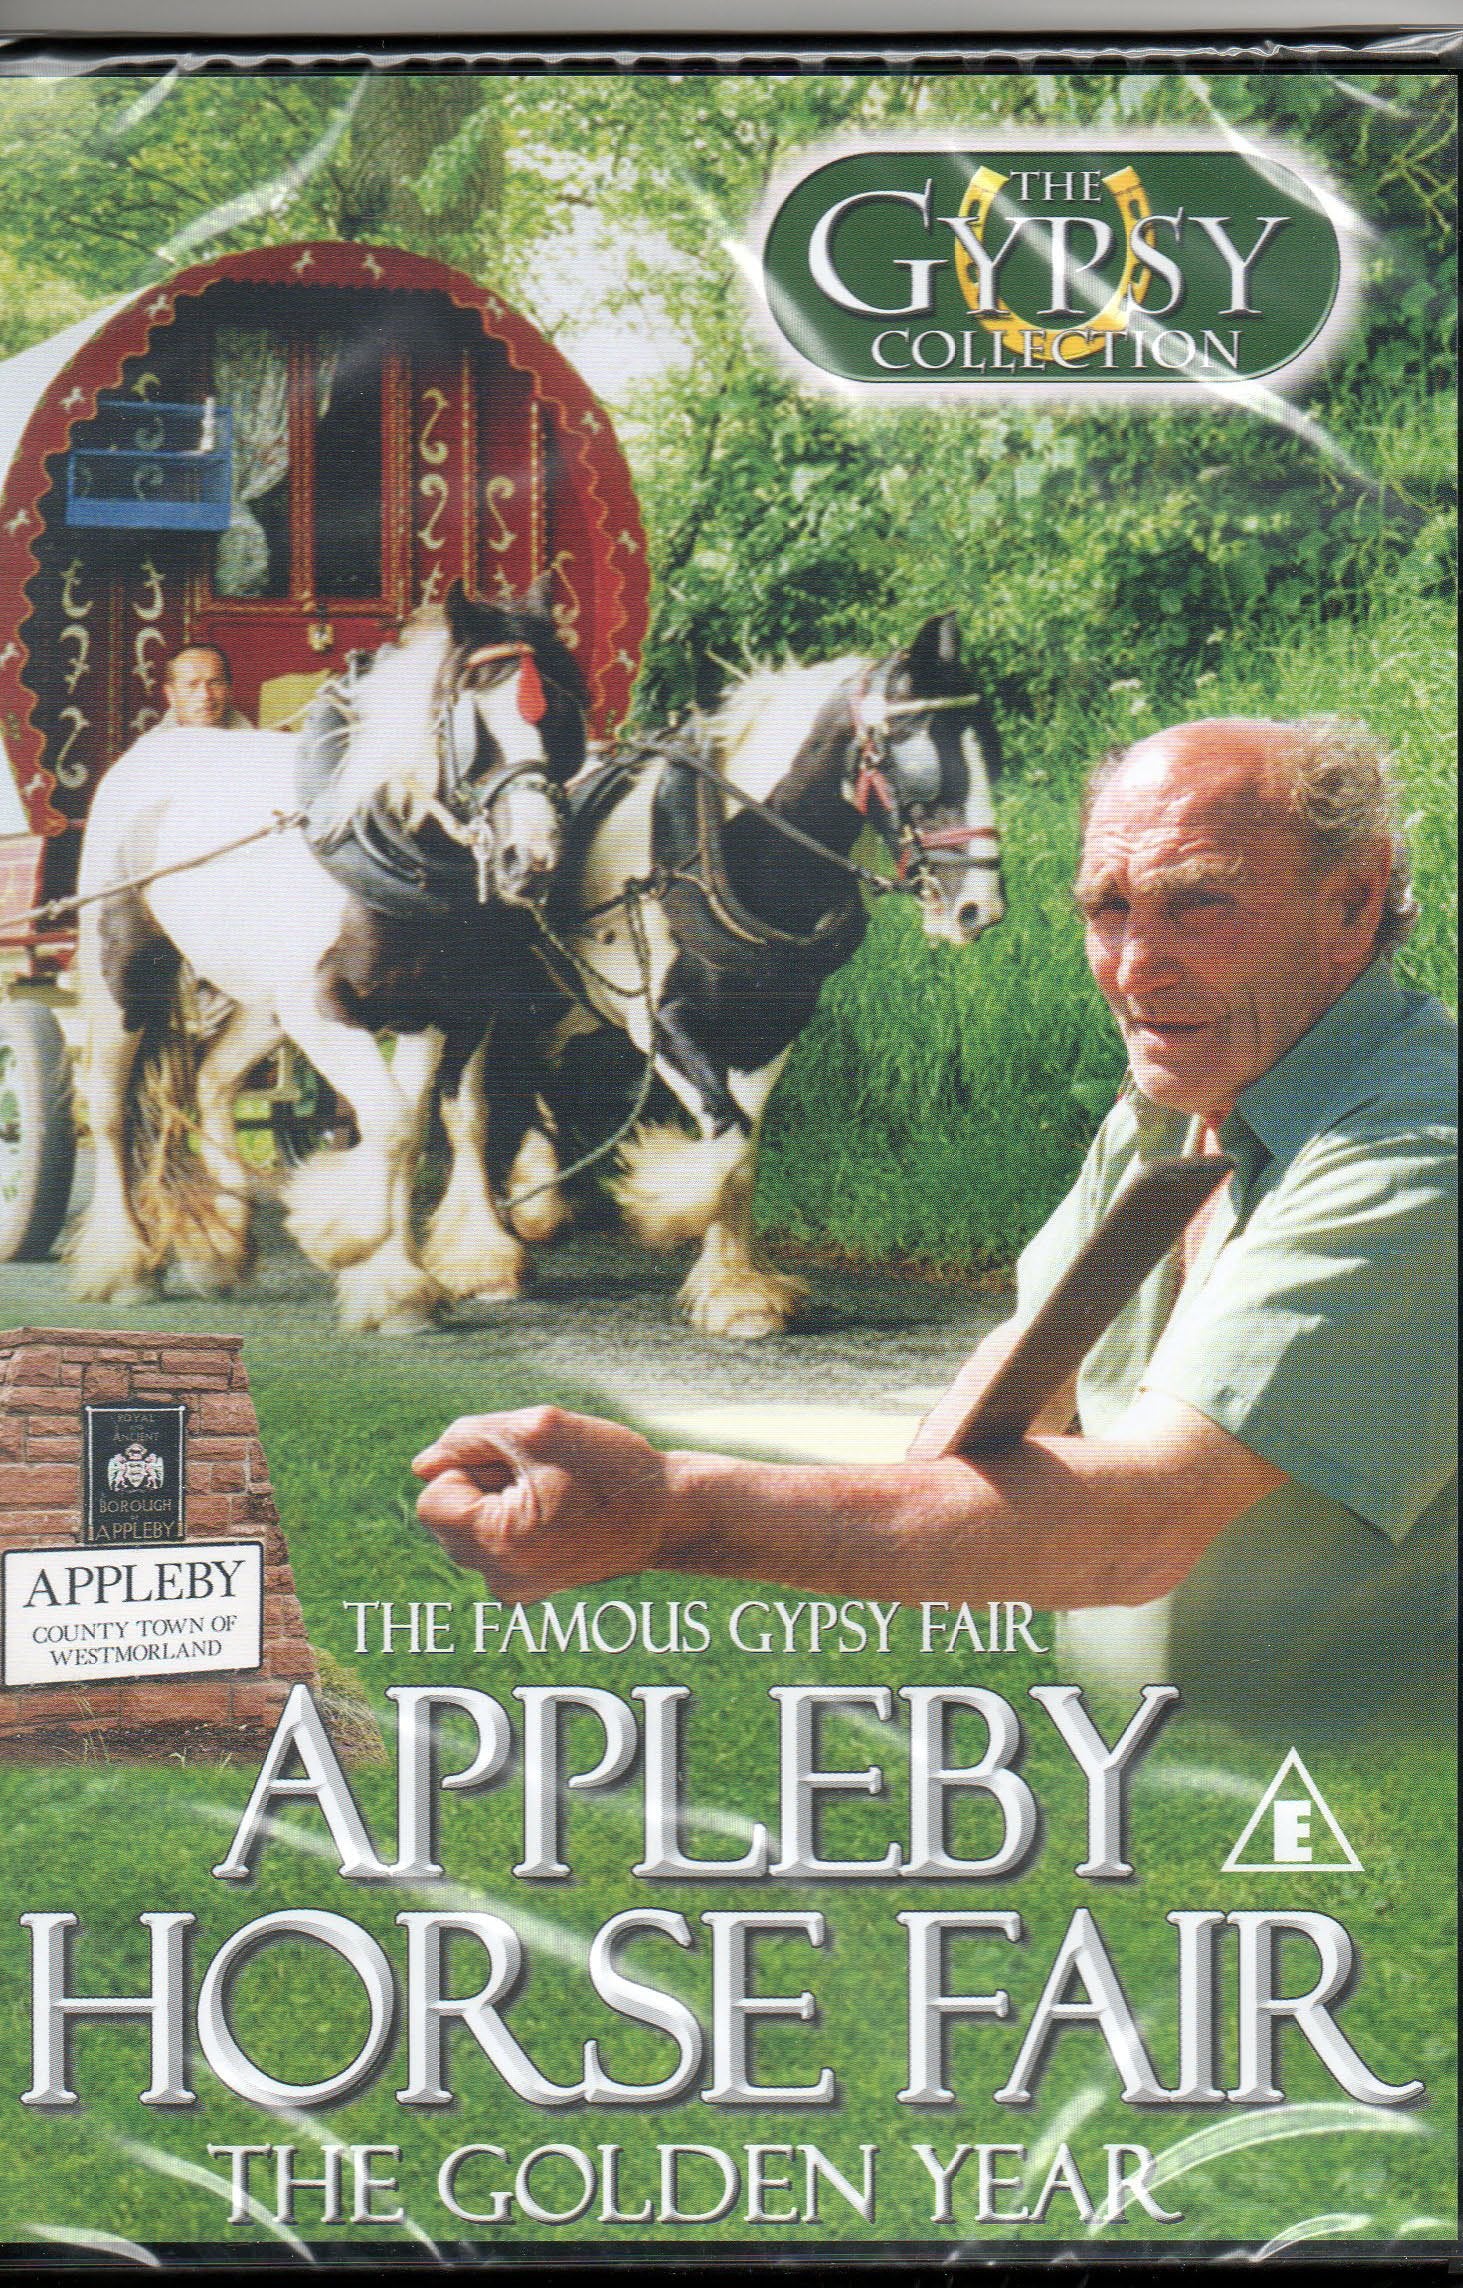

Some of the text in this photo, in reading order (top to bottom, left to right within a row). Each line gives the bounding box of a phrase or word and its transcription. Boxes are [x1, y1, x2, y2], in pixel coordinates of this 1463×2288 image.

[1009, 170, 1101, 202] THE
[808, 177, 1292, 318] GYPSY
[870, 329, 1243, 376] COLLECTION
[99, 1498, 172, 1513] BOROUGH
[95, 1521, 175, 1541] APPLEBY
[22, 1559, 247, 1608] APPLEBY
[32, 1614, 239, 1644] COUNTY TOWN OF
[343, 1600, 1050, 1655] THE FAMOUS GYPSY FAIR
[50, 1638, 223, 1667] WESTMORLAND
[212, 1684, 1180, 1880] APPLEBY
[1273, 1800, 1312, 1862] E
[20, 1908, 1425, 2106] HORSE FAIR
[207, 2142, 1183, 2224] THE GOLDEN YEAR
